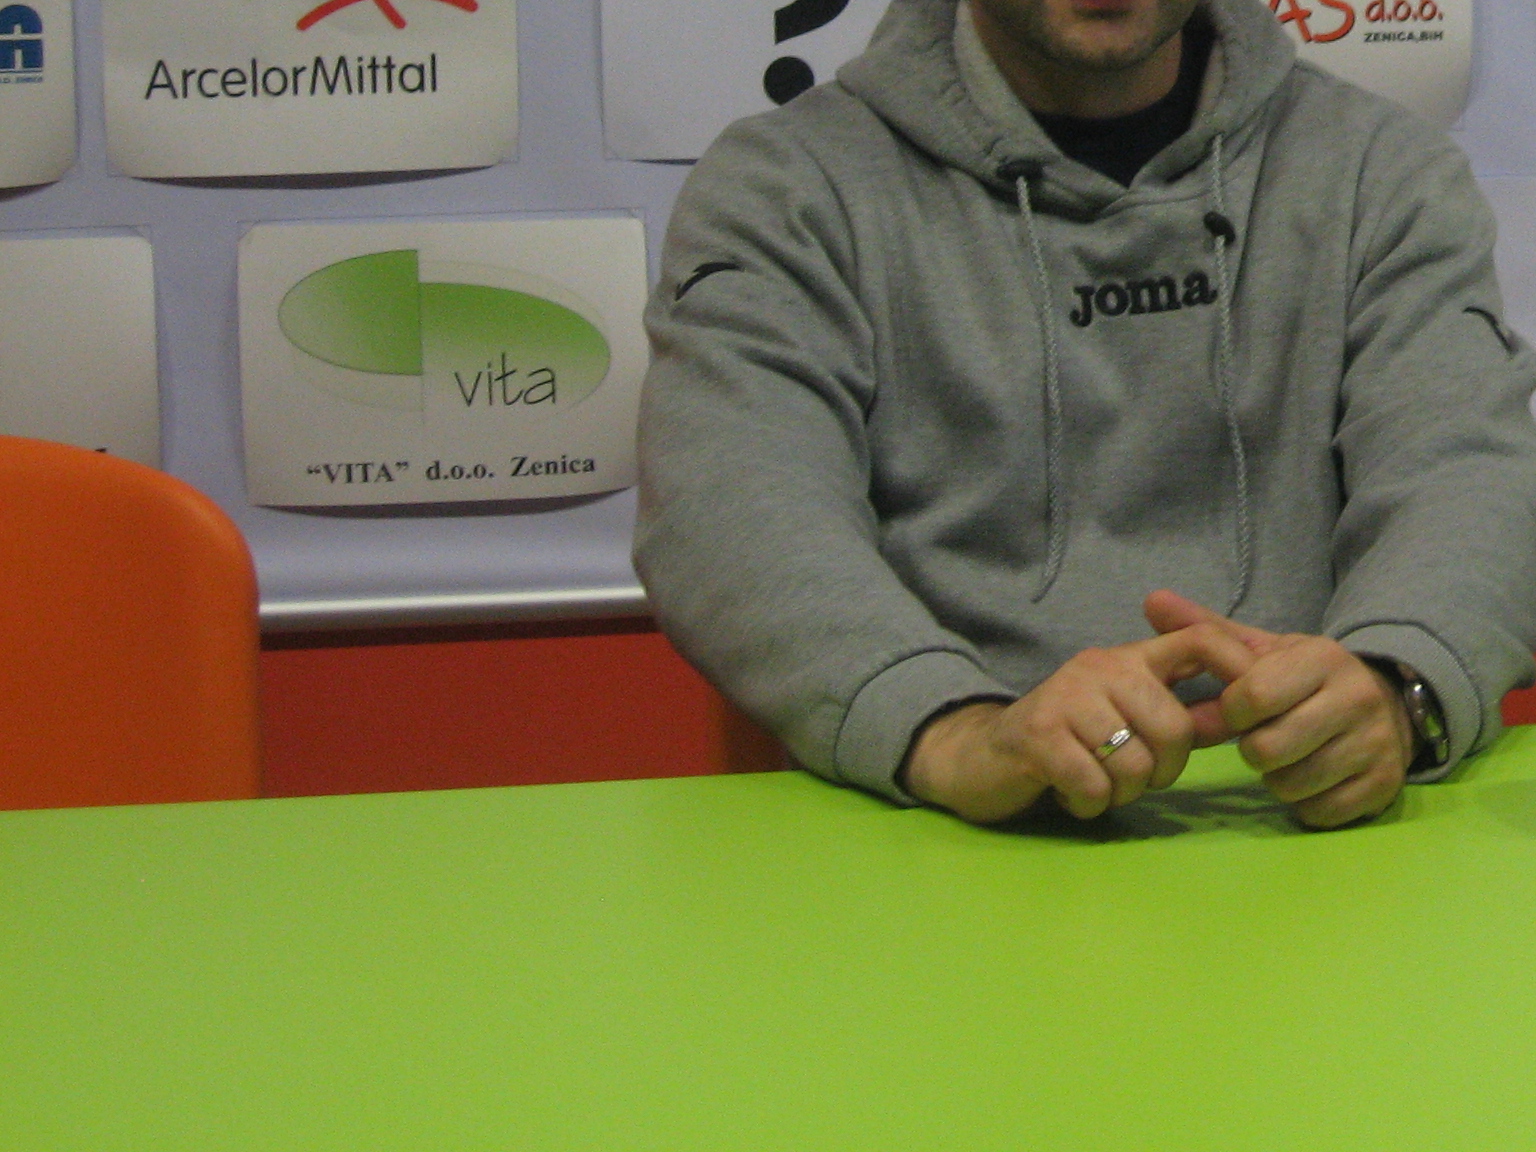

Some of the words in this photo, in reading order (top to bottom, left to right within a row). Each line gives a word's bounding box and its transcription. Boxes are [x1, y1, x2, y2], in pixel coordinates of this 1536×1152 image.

[145, 53, 438, 100] ArcelorMittal
[454, 351, 557, 407] vita
[425, 460, 495, 481] d.o.o.
[510, 456, 596, 478] Zenica
